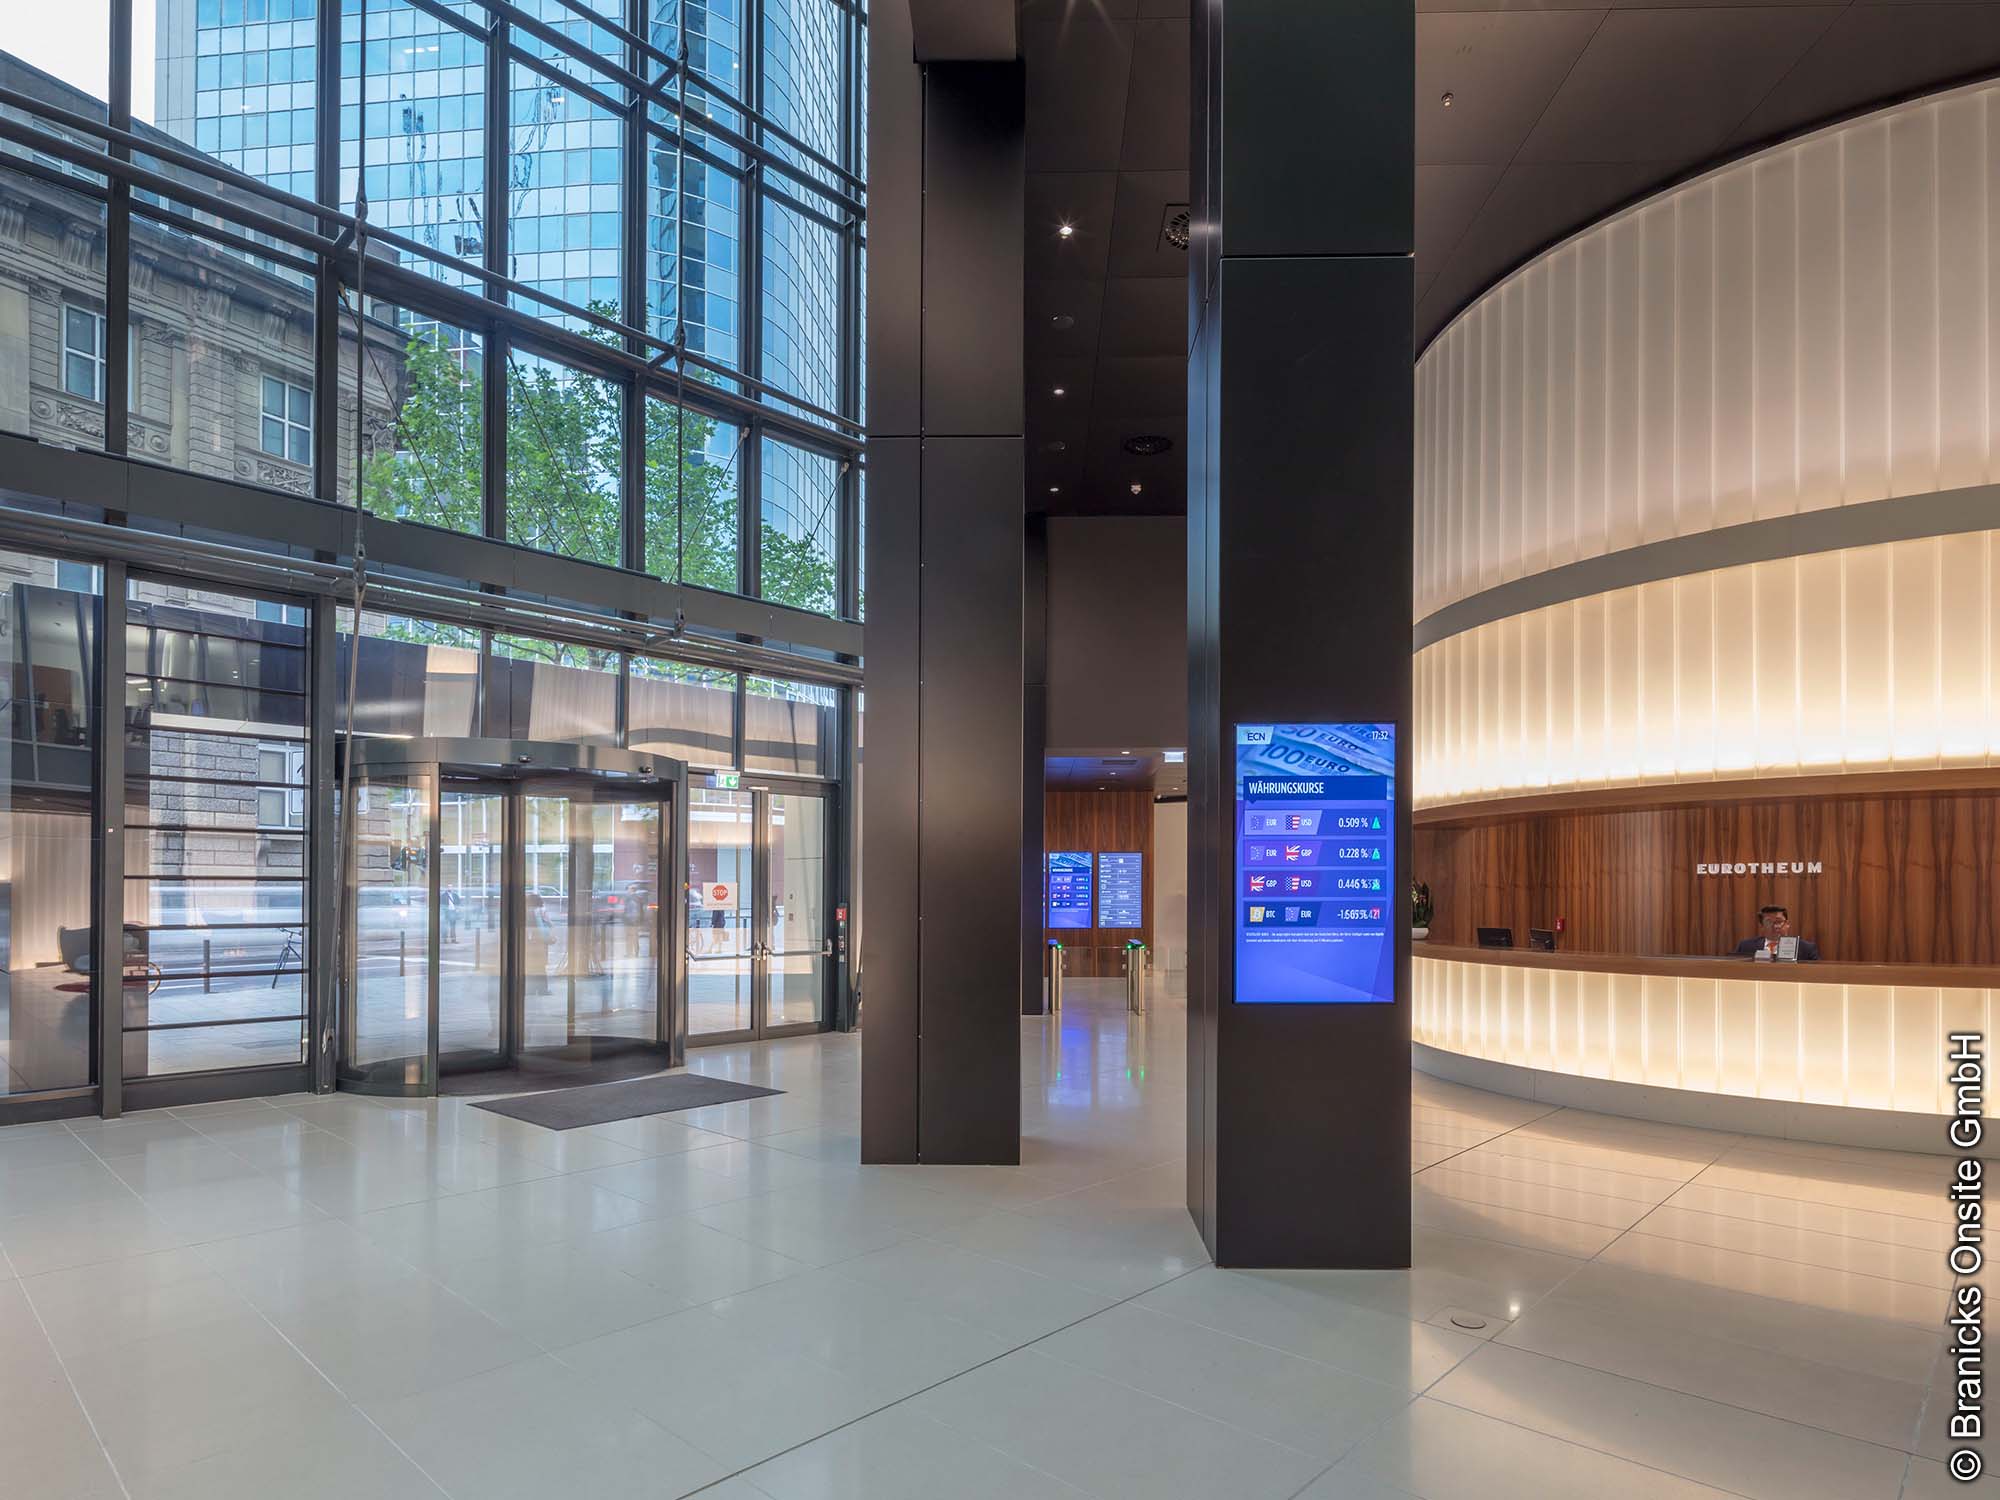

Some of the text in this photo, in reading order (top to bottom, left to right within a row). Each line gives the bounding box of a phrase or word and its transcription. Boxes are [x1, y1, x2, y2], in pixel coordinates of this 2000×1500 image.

[1247, 732, 1266, 741] ECN
[1372, 730, 1389, 740] 17:32
[1319, 732, 1359, 751] EURO
[1259, 744, 1351, 773] 100 EURO
[1249, 780, 1325, 794] WÄHRUNGSKURSE
[1266, 818, 1277, 826] EUR
[1301, 818, 1312, 826] USD
[1338, 817, 1360, 828] 0.509
[1266, 849, 1277, 857] EUR
[1301, 849, 1312, 857] GBP
[1339, 848, 1360, 859] 0.228
[1697, 862, 1822, 875] EUROTHEUM
[1266, 880, 1277, 888] GBP
[1301, 880, 1312, 888] USD
[712, 889, 728, 897] STOP
[1266, 910, 1276, 918] BTC
[1301, 910, 1312, 919] EUR
